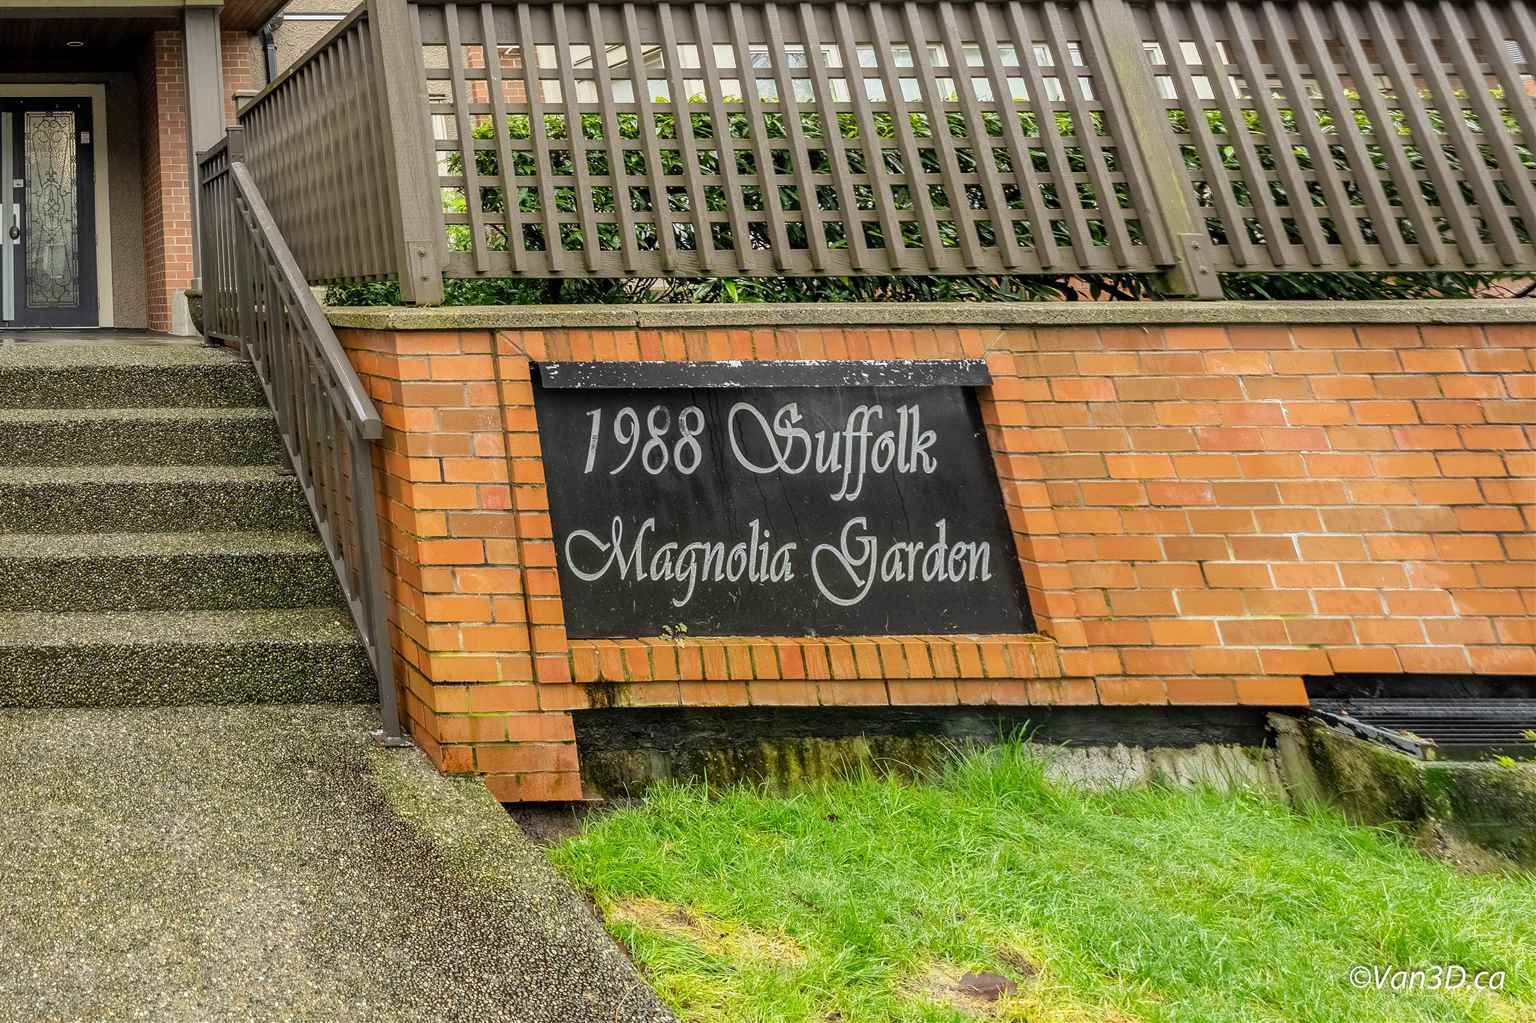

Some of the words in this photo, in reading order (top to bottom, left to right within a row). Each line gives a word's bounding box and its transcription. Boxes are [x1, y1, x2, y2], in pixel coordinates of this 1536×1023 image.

[584, 406, 705, 475] 1988
[728, 402, 938, 501] Suffolk
[565, 516, 797, 607] Magnolia
[812, 516, 992, 607] Garden
